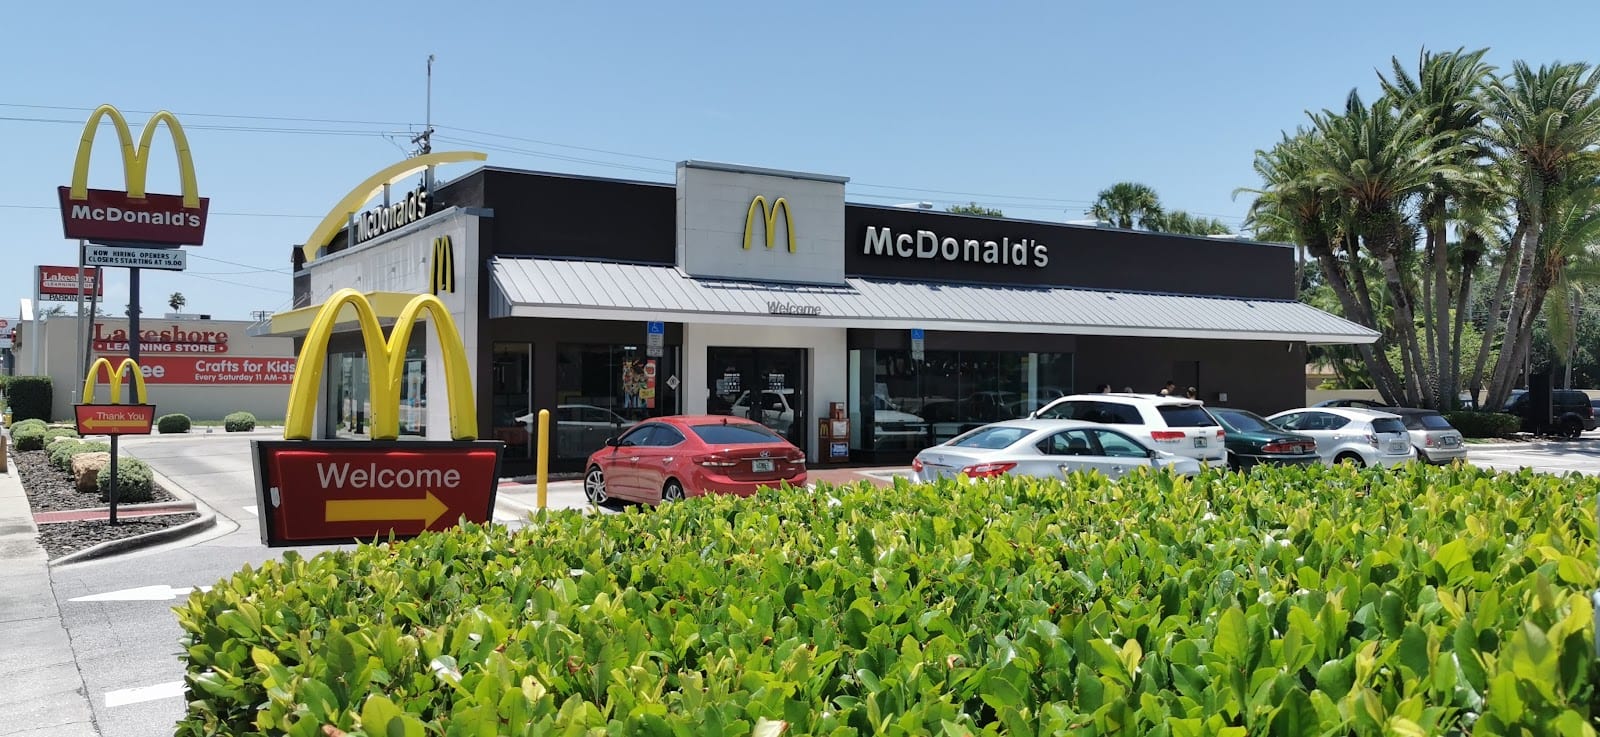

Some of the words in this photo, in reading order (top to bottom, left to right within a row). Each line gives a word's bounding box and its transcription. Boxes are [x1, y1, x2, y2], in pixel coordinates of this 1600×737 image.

[71, 204, 201, 228] McDonald's
[357, 187, 428, 243] McDonald's
[863, 226, 1049, 268] McDonald's
[88, 256, 119, 264] CLOSERS
[120, 257, 153, 265] STARTING
[112, 250, 136, 258] HIRING
[139, 252, 170, 260] OPENERS
[767, 300, 822, 316] Welcome
[106, 343, 172, 352] LEANING
[175, 343, 216, 352] STORE
[195, 360, 240, 372] Crafts
[243, 360, 263, 373] for
[267, 361, 296, 373] Kids
[194, 373, 217, 383] Every
[218, 373, 253, 383] Saturday
[255, 373, 262, 381] 11
[96, 411, 125, 421] Thank
[127, 412, 145, 421] You
[316, 462, 461, 489] Welcome
